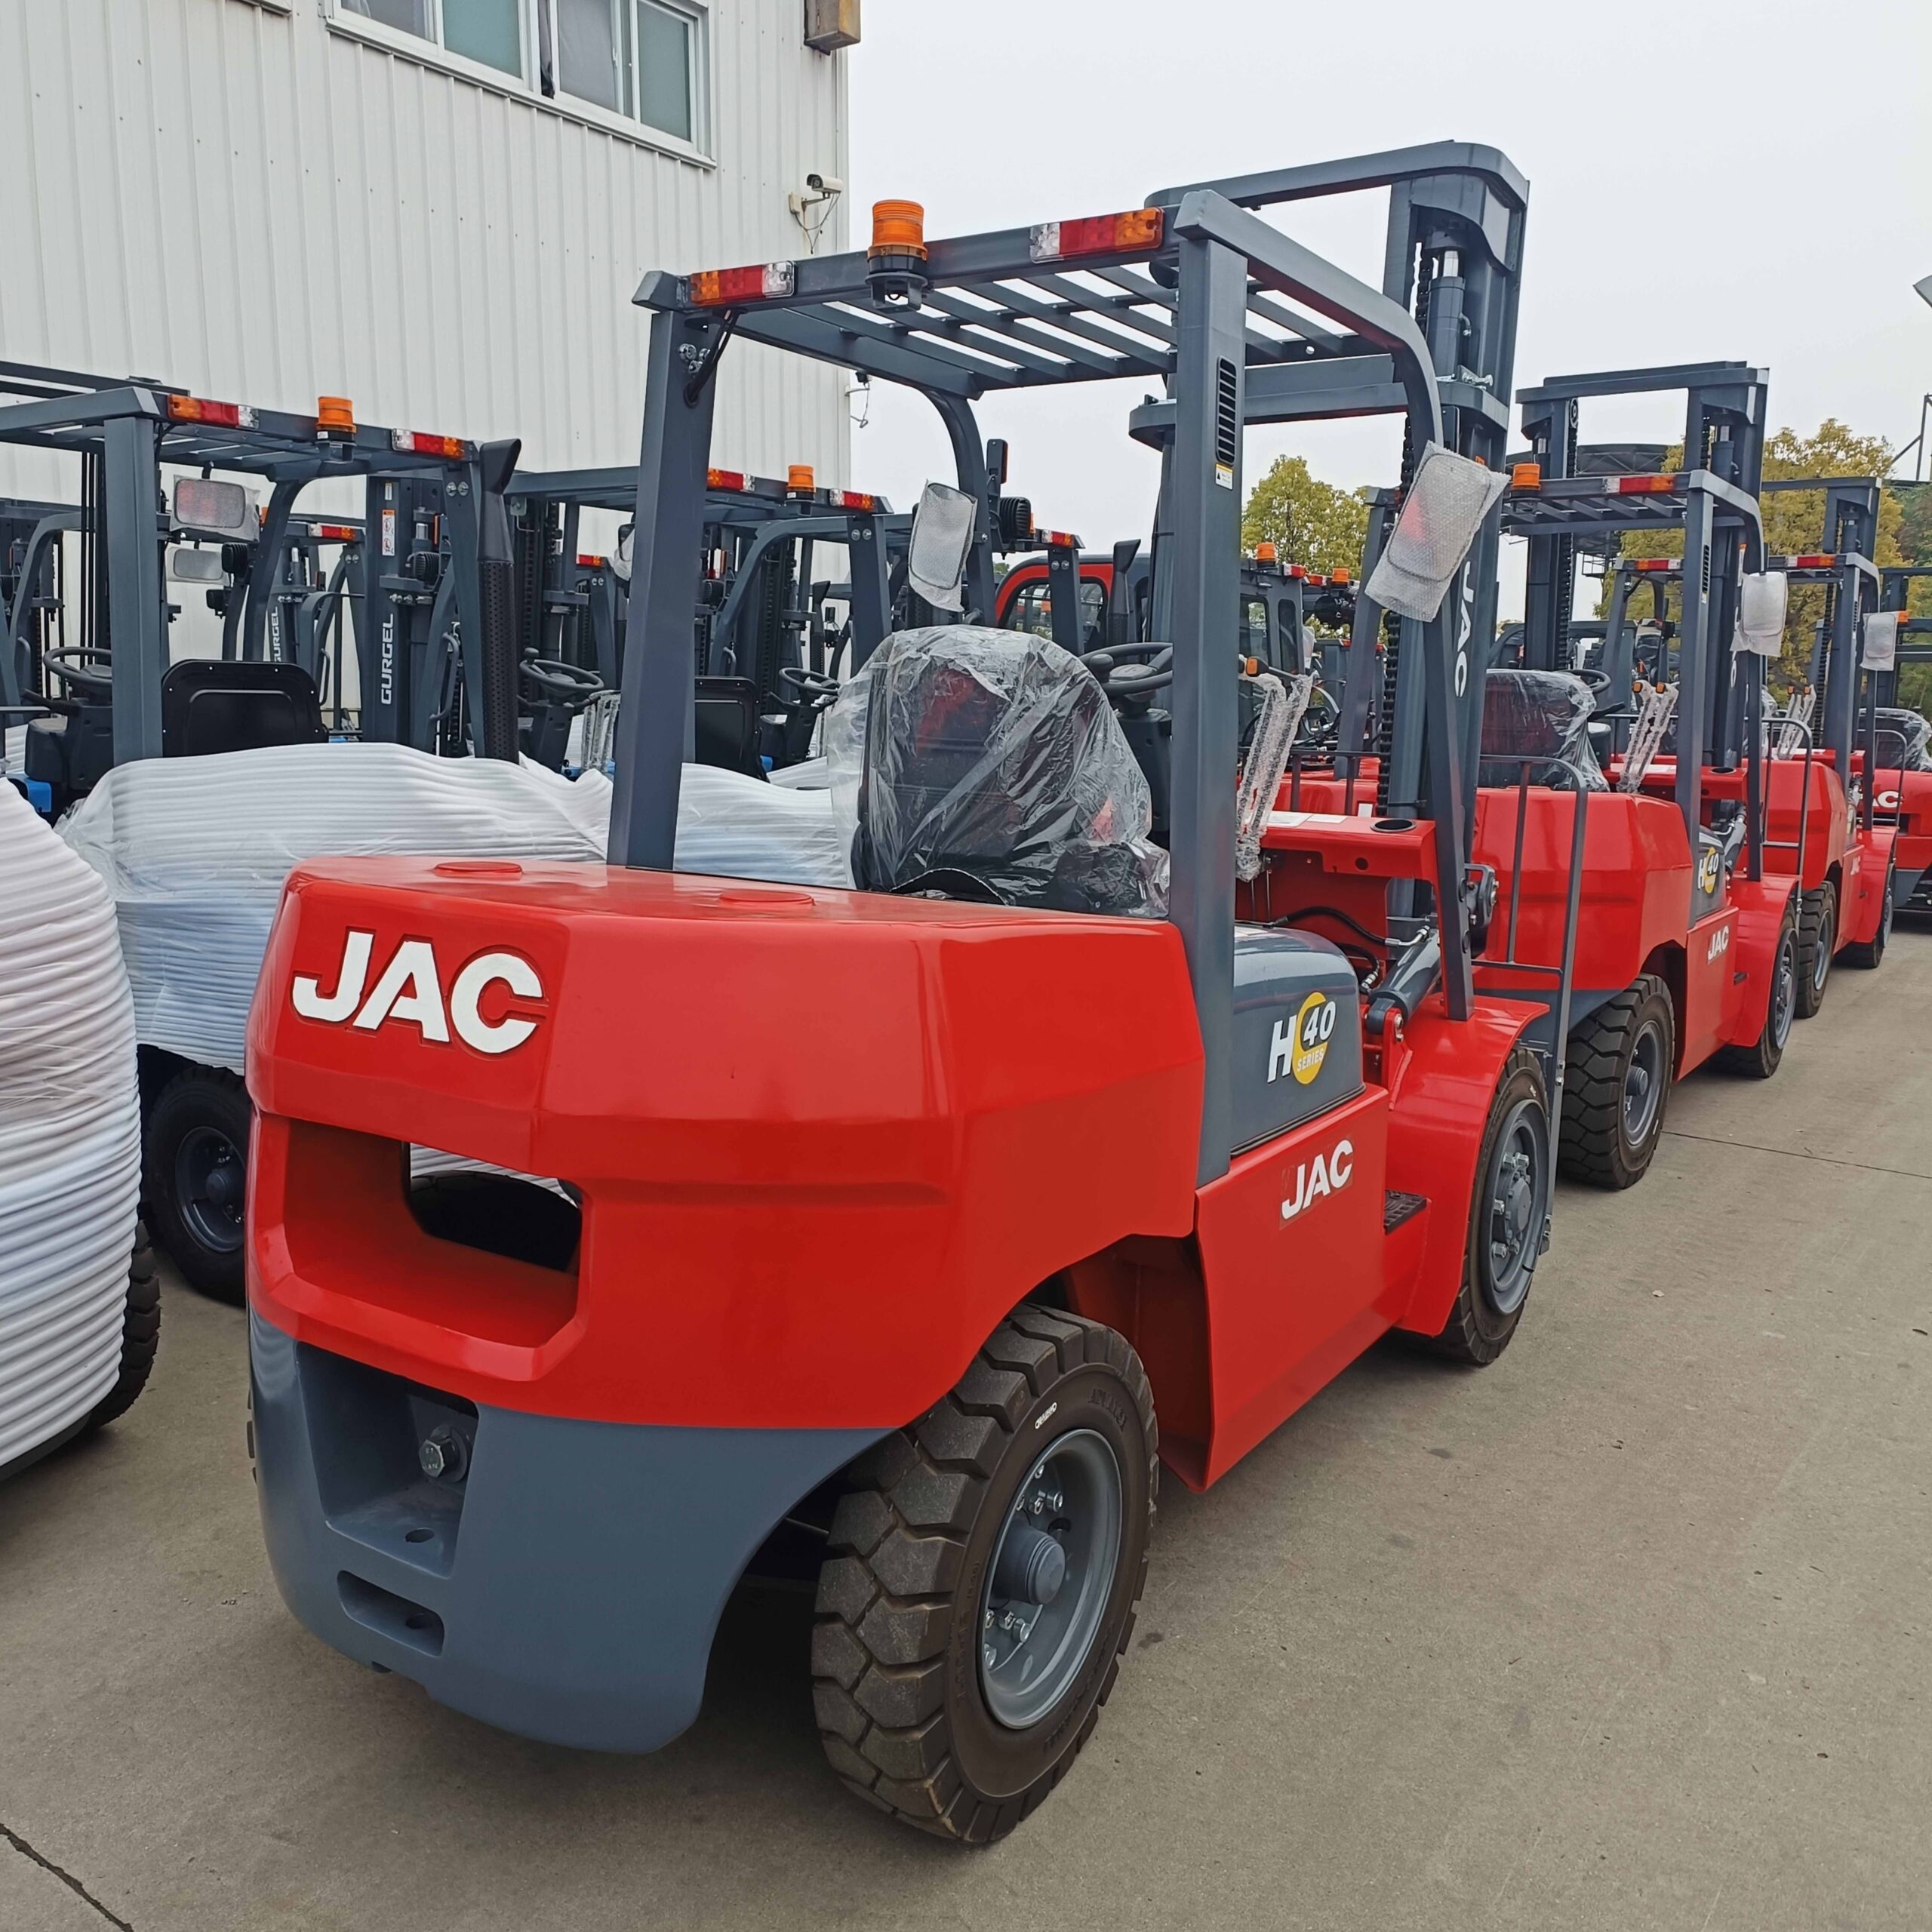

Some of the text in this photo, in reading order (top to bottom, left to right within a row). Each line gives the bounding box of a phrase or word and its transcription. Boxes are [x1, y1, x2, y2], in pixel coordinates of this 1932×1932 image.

[380, 613, 394, 705] GURGEL
[1454, 561, 1475, 698] JAC
[1707, 924, 1729, 961] JAC
[293, 931, 543, 1054] JAC
[1303, 1001, 1336, 1047] 40
[1297, 1048, 1325, 1072] SERIES
[1281, 1140, 1353, 1220] JAC
